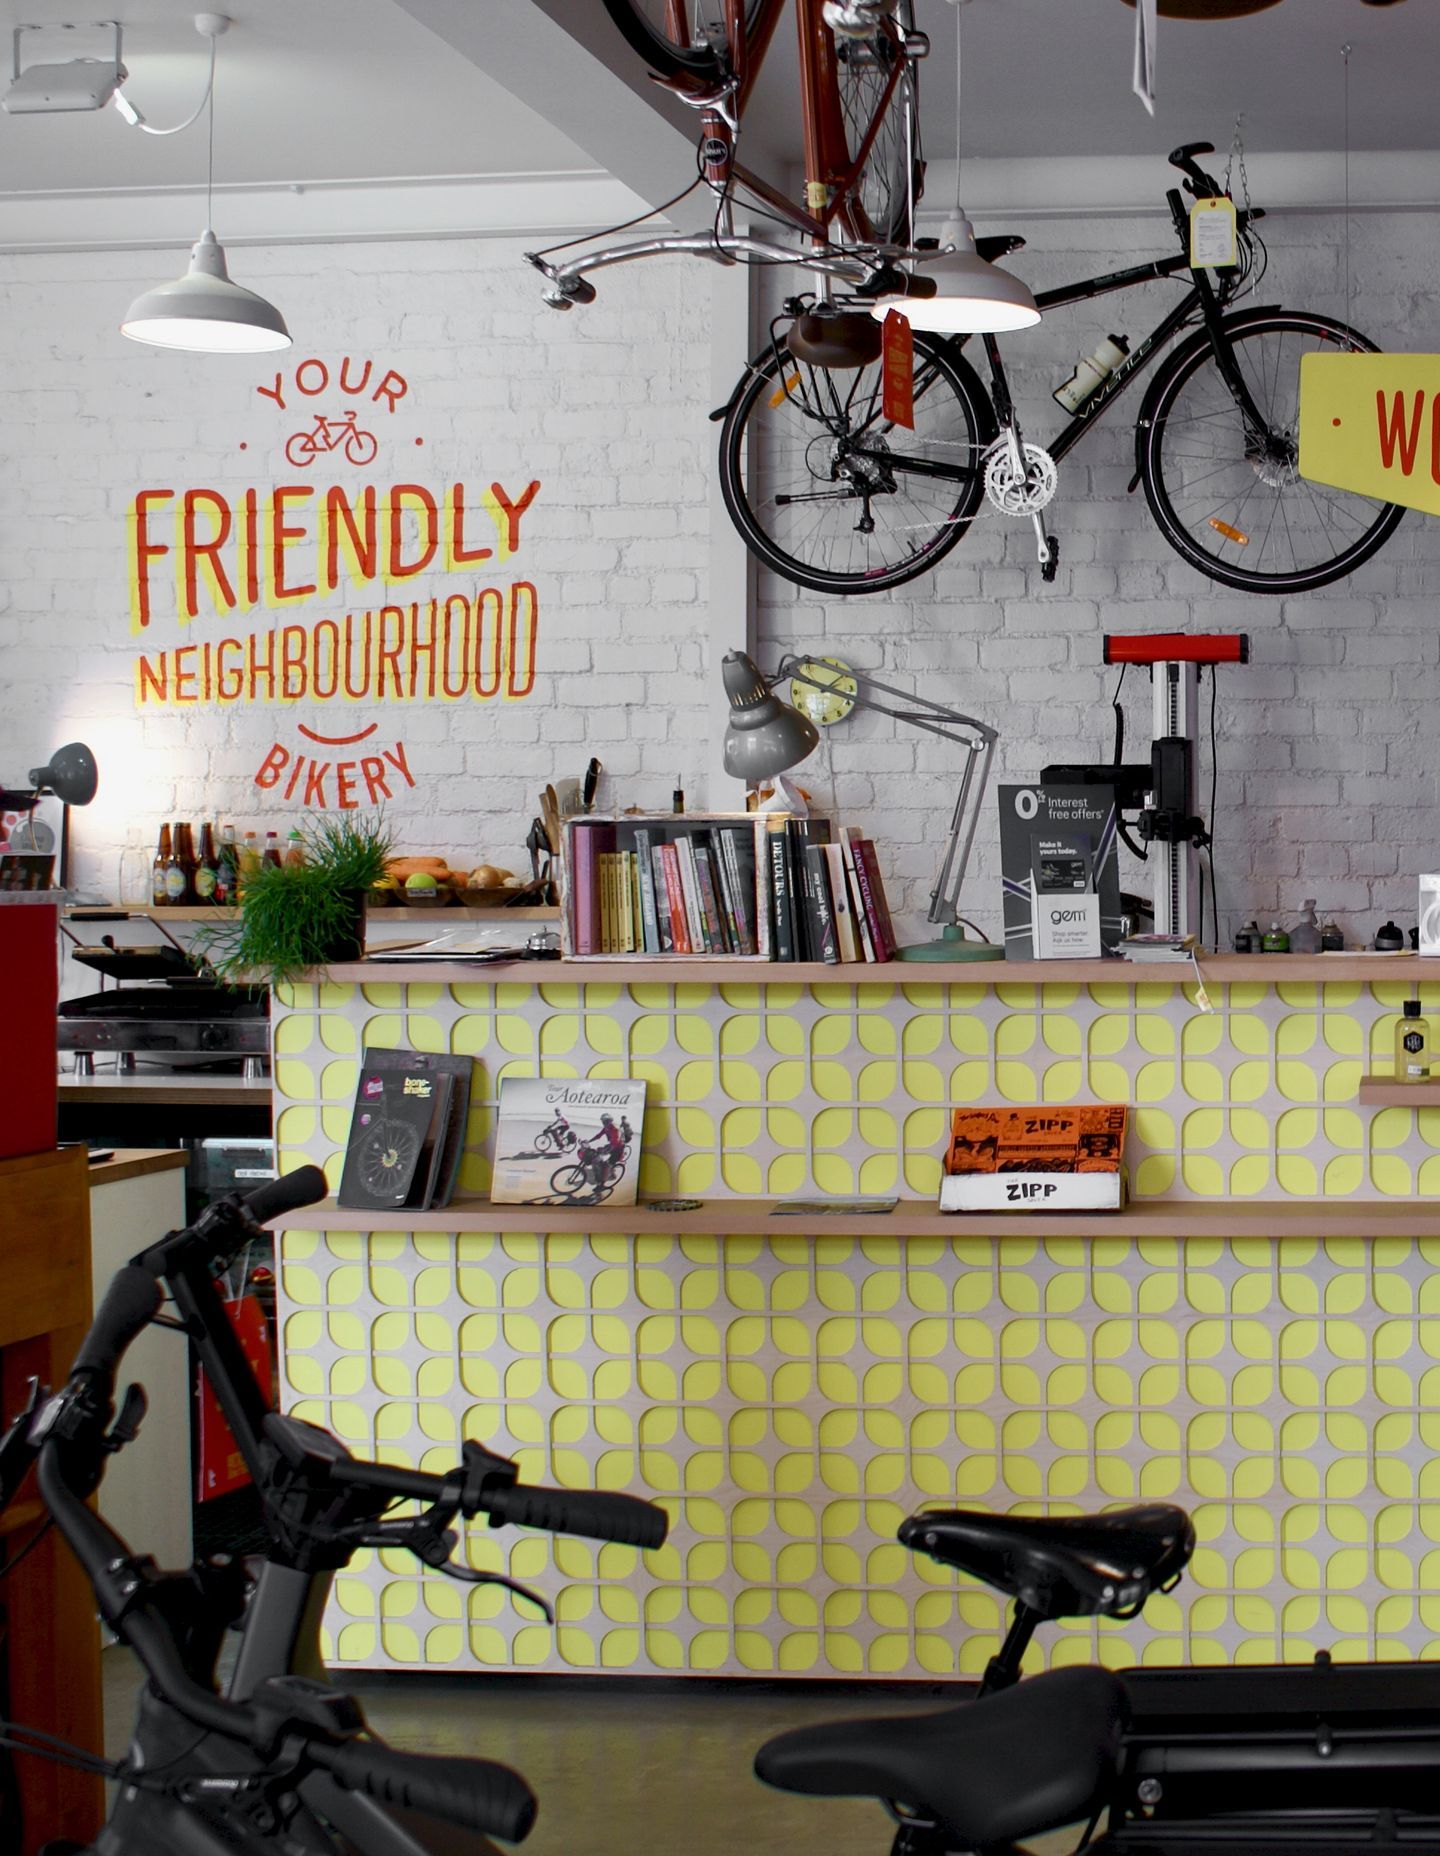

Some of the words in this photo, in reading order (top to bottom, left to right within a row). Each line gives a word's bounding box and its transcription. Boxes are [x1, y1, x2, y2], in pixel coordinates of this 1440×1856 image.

[256, 356, 408, 414] YOUR
[136, 480, 542, 627] FRIENDLY
[137, 581, 539, 702] NEIGHBOURHOOD
[254, 741, 416, 809] BIKERY
[1048, 797, 1088, 808] Interest
[1048, 808, 1070, 819] free
[772, 841, 785, 897] DETOURS
[853, 848, 866, 875] FANCY
[860, 876, 874, 911] CYCLING
[1050, 910, 1086, 925] gem
[545, 1086, 632, 1105] Aotearoa
[1025, 1118, 1074, 1134] ZIPP
[1006, 1183, 1058, 1201] ZIPP
